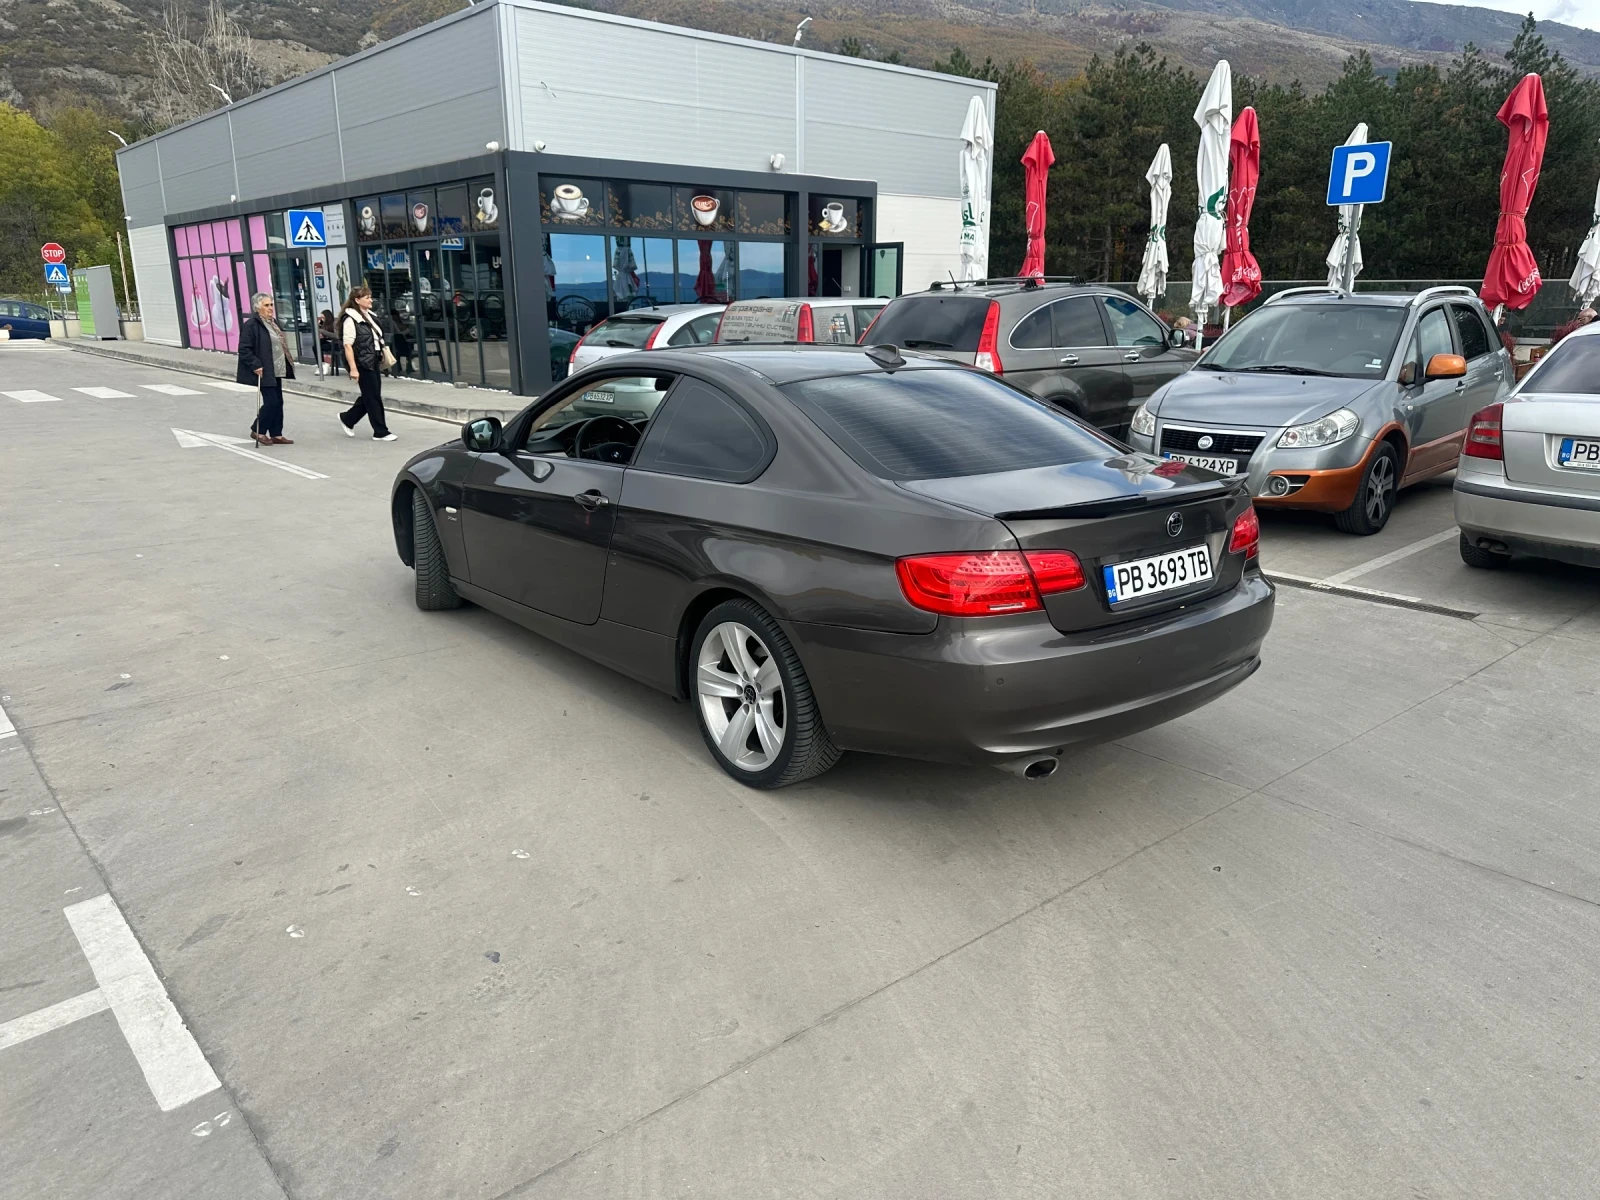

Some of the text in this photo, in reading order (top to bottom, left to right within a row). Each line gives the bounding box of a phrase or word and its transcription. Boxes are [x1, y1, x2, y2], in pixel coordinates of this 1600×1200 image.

[1342, 152, 1376, 197] P
[43, 249, 63, 258] STOP
[1573, 442, 1600, 461] PB
[1218, 459, 1235, 473] XP
[1117, 550, 1209, 596] PB 3693 TB
[1107, 588, 1117, 598] BG
